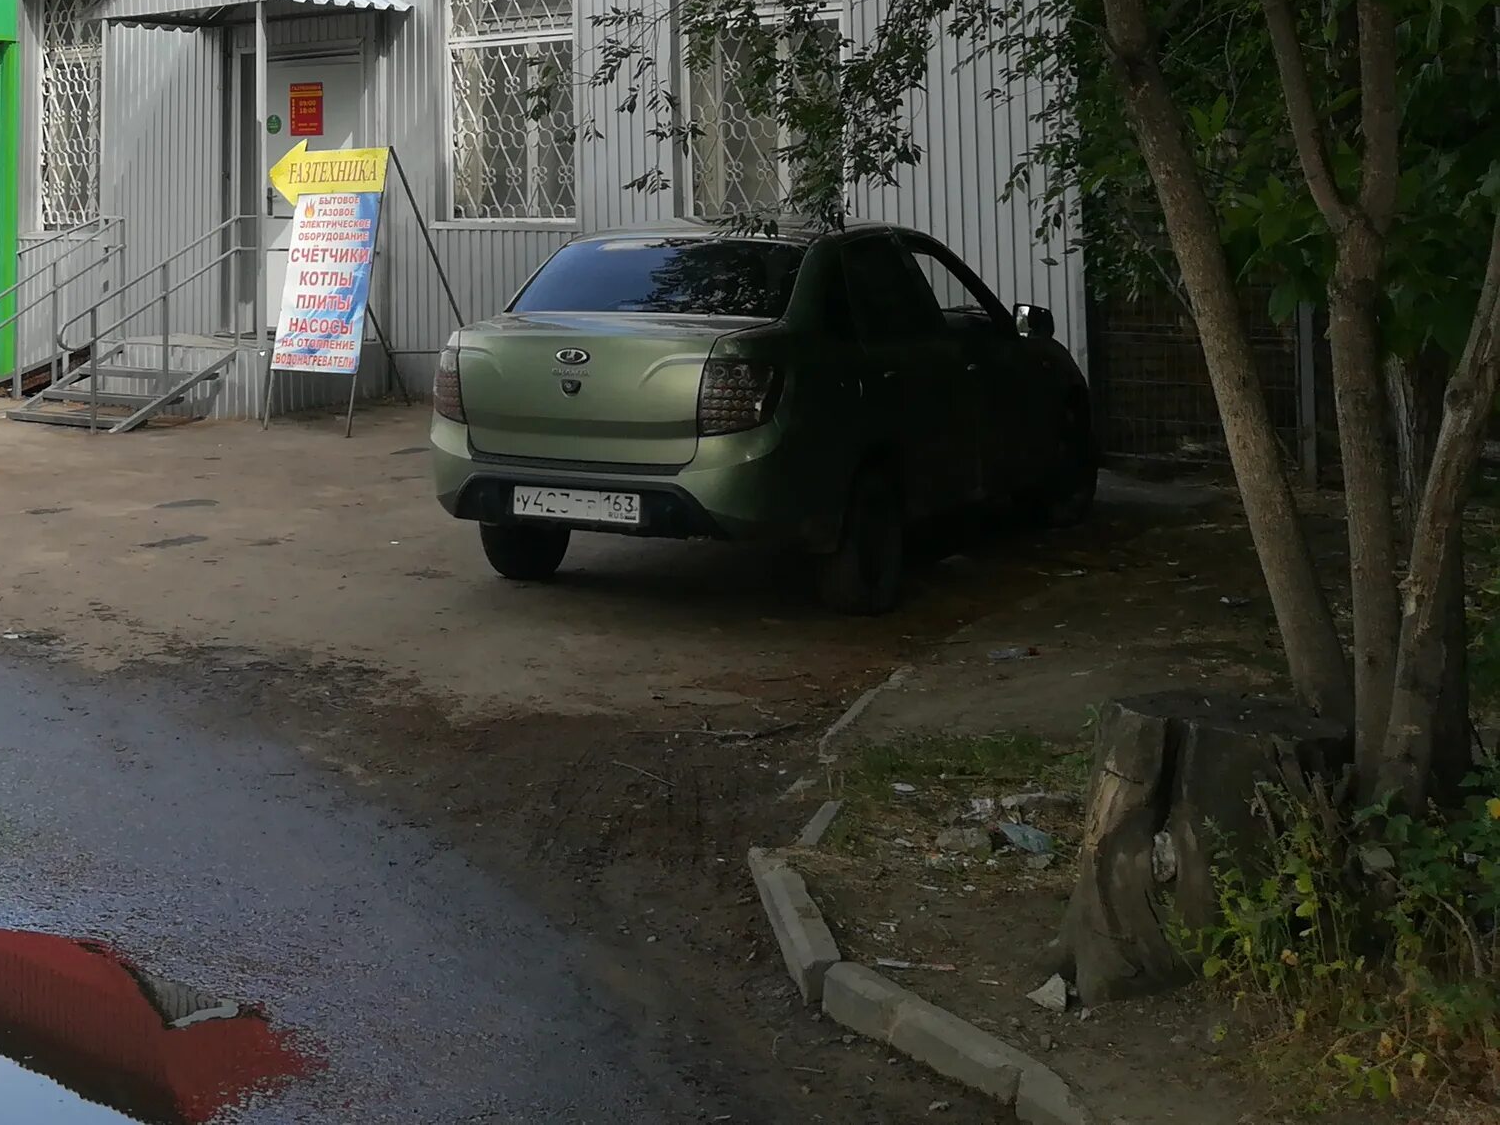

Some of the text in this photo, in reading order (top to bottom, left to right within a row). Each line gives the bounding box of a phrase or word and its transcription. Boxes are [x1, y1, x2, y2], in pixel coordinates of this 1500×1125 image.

[318, 196, 360, 205] БЫТОВОЕ
[316, 207, 356, 217] ГАЗОВОЕ
[299, 219, 371, 229] ЭЛЕКТРИЧЕСКОЕ
[298, 231, 370, 242] ОБОРУДОВАНИЕ
[290, 244, 371, 264] СЧЁТЧИКИ
[299, 270, 354, 288] КОТЛЫ
[295, 293, 352, 311] ПЛИТЫ
[288, 317, 355, 335] НАСОСЫ
[281, 337, 356, 351] НА ОТОПЛЕНИЕ
[603, 493, 635, 513] 163
[608, 511, 625, 520] RUS
